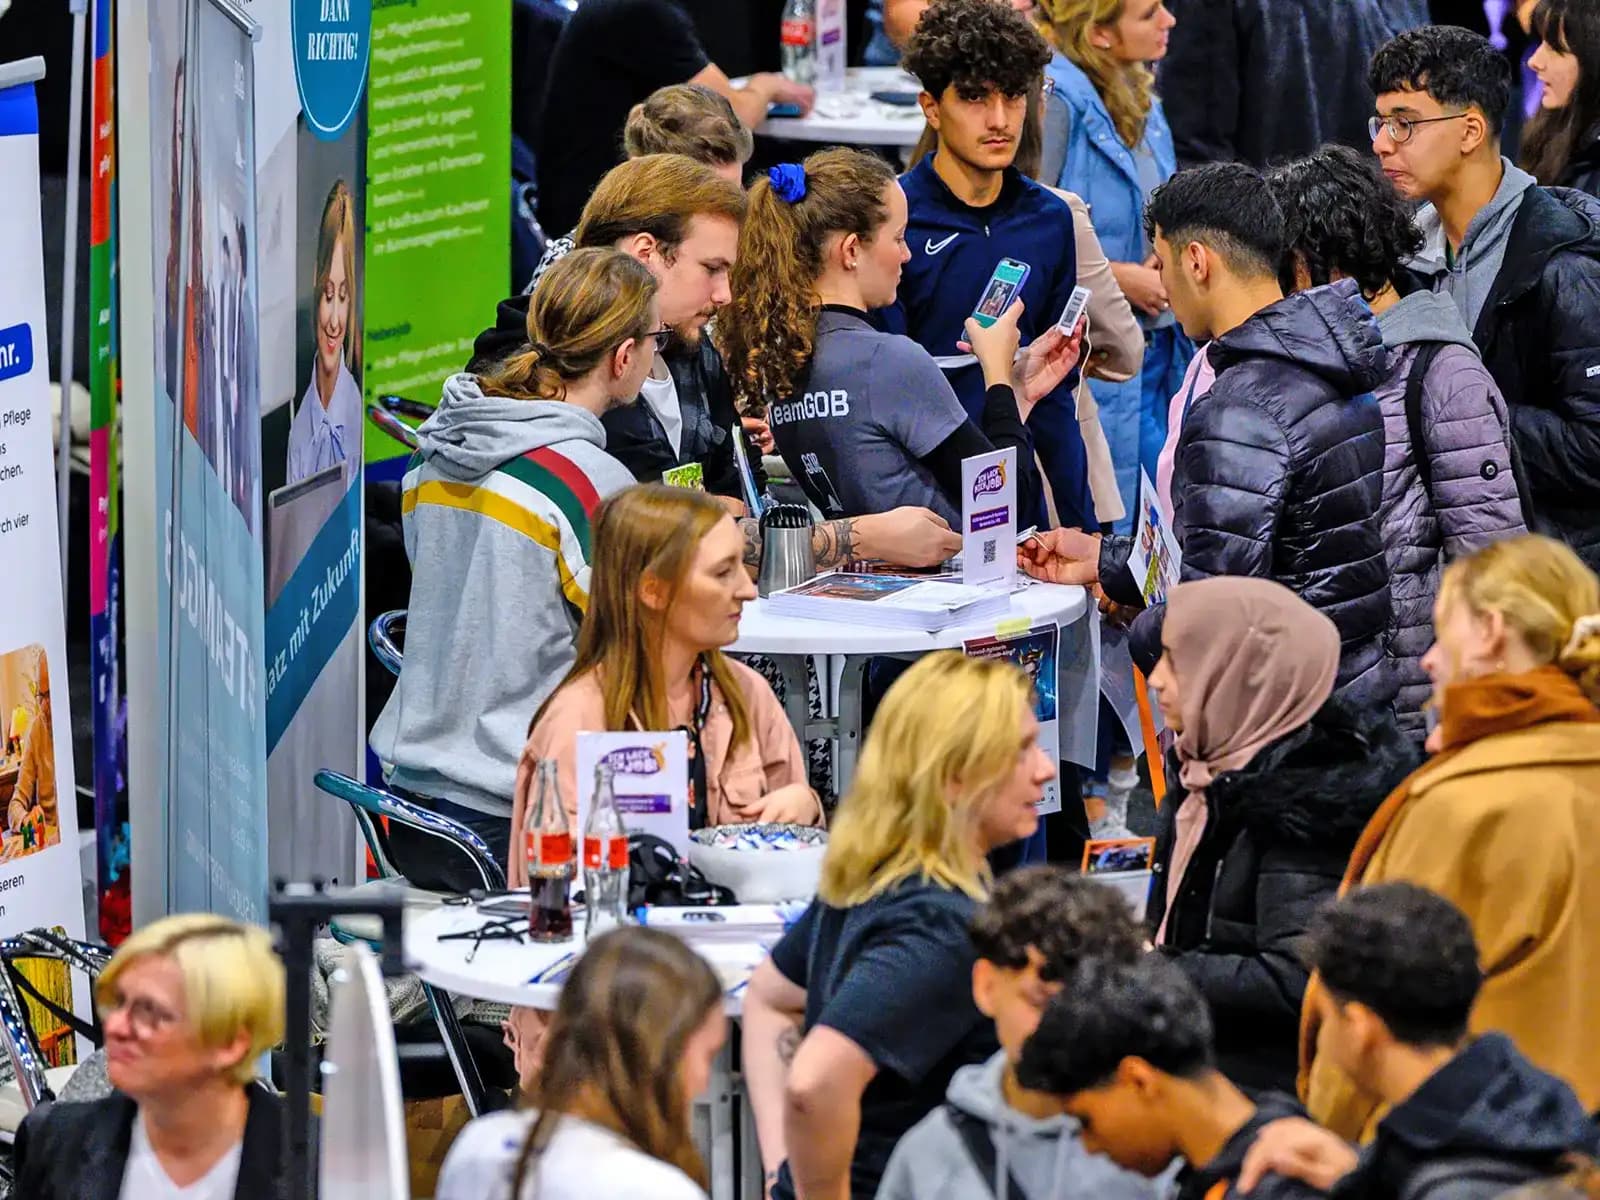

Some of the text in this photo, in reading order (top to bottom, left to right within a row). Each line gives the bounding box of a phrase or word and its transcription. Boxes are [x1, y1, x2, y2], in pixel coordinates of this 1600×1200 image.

[320, 0, 350, 22] DANN
[307, 32, 359, 61] RICHTIG!
[3, 408, 31, 426] Pflege
[13, 513, 29, 529] vier
[289, 606, 310, 661] mit
[311, 527, 360, 625] Zukunft
